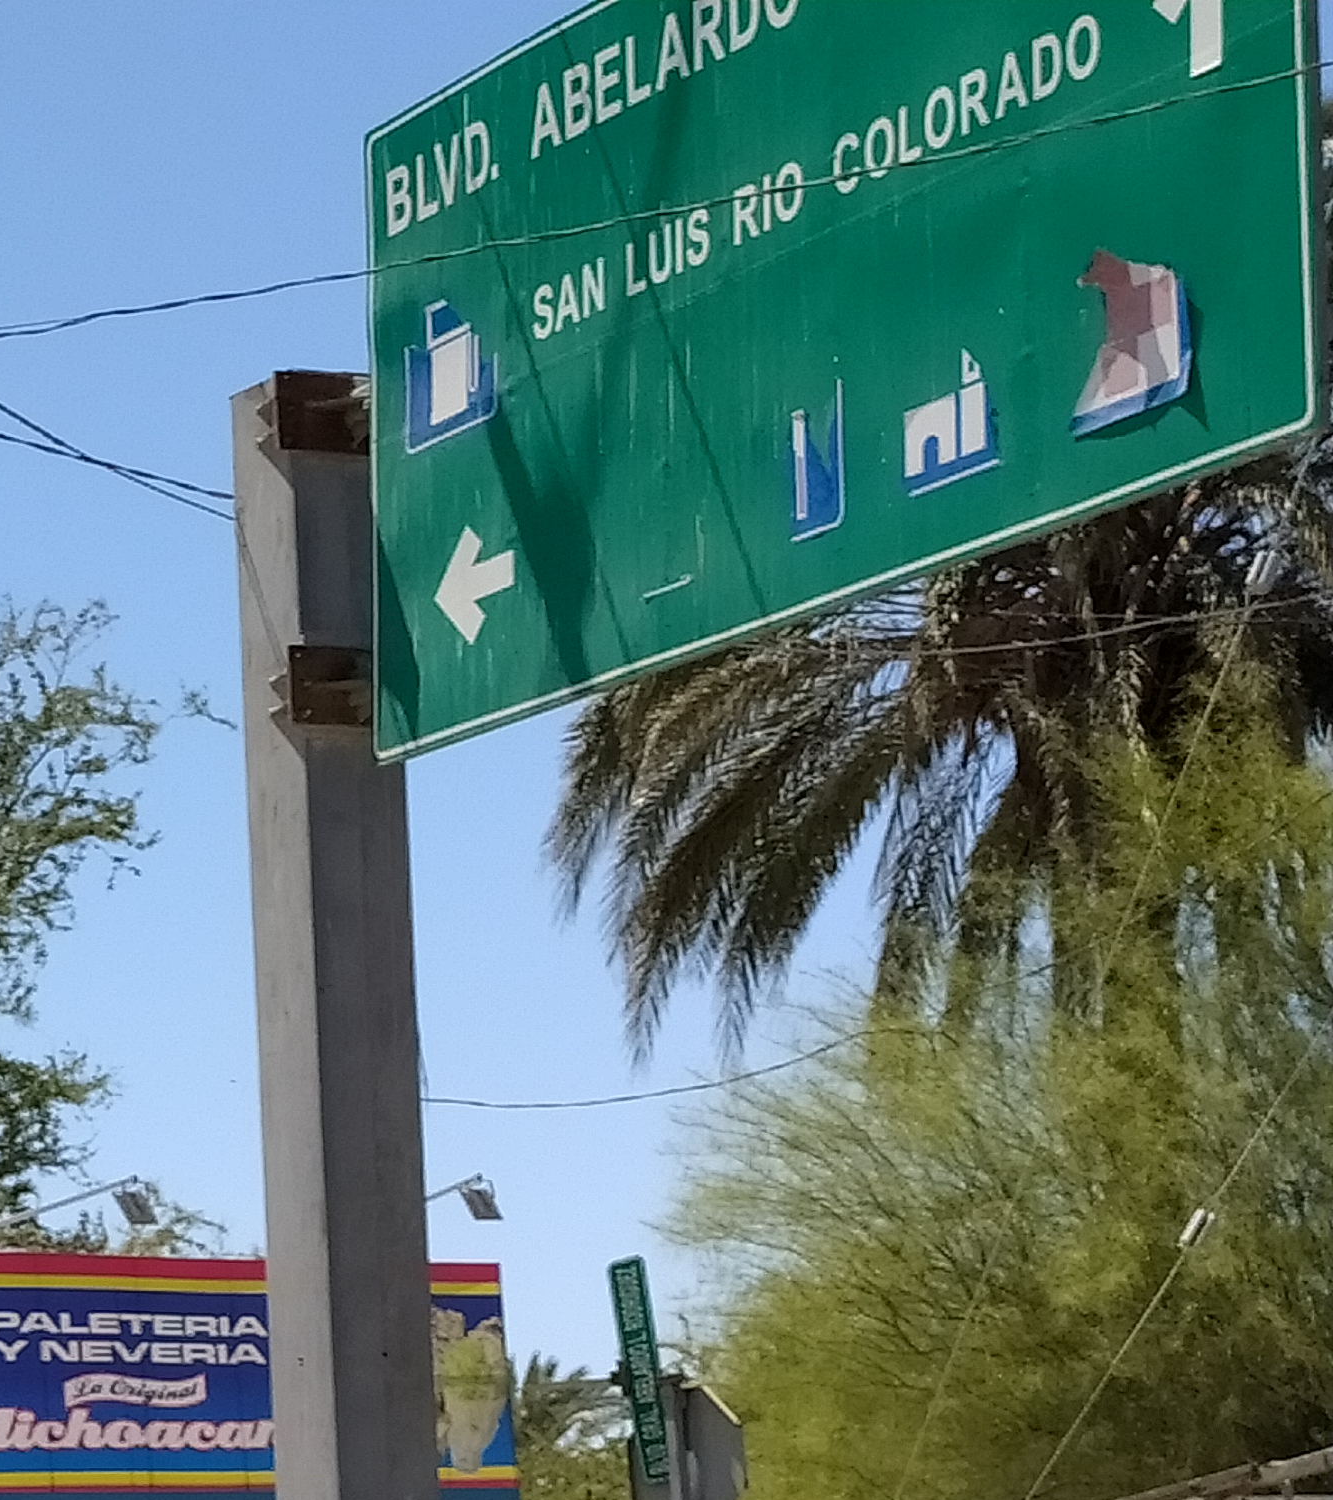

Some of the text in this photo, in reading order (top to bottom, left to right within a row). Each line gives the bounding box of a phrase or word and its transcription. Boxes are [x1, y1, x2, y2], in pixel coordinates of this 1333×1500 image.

[386, 119, 500, 239] BLVD.
[532, 13, 1101, 340] SAN LUIS RIO COLORADO
[39, 1340, 268, 1365] NEVERIA
